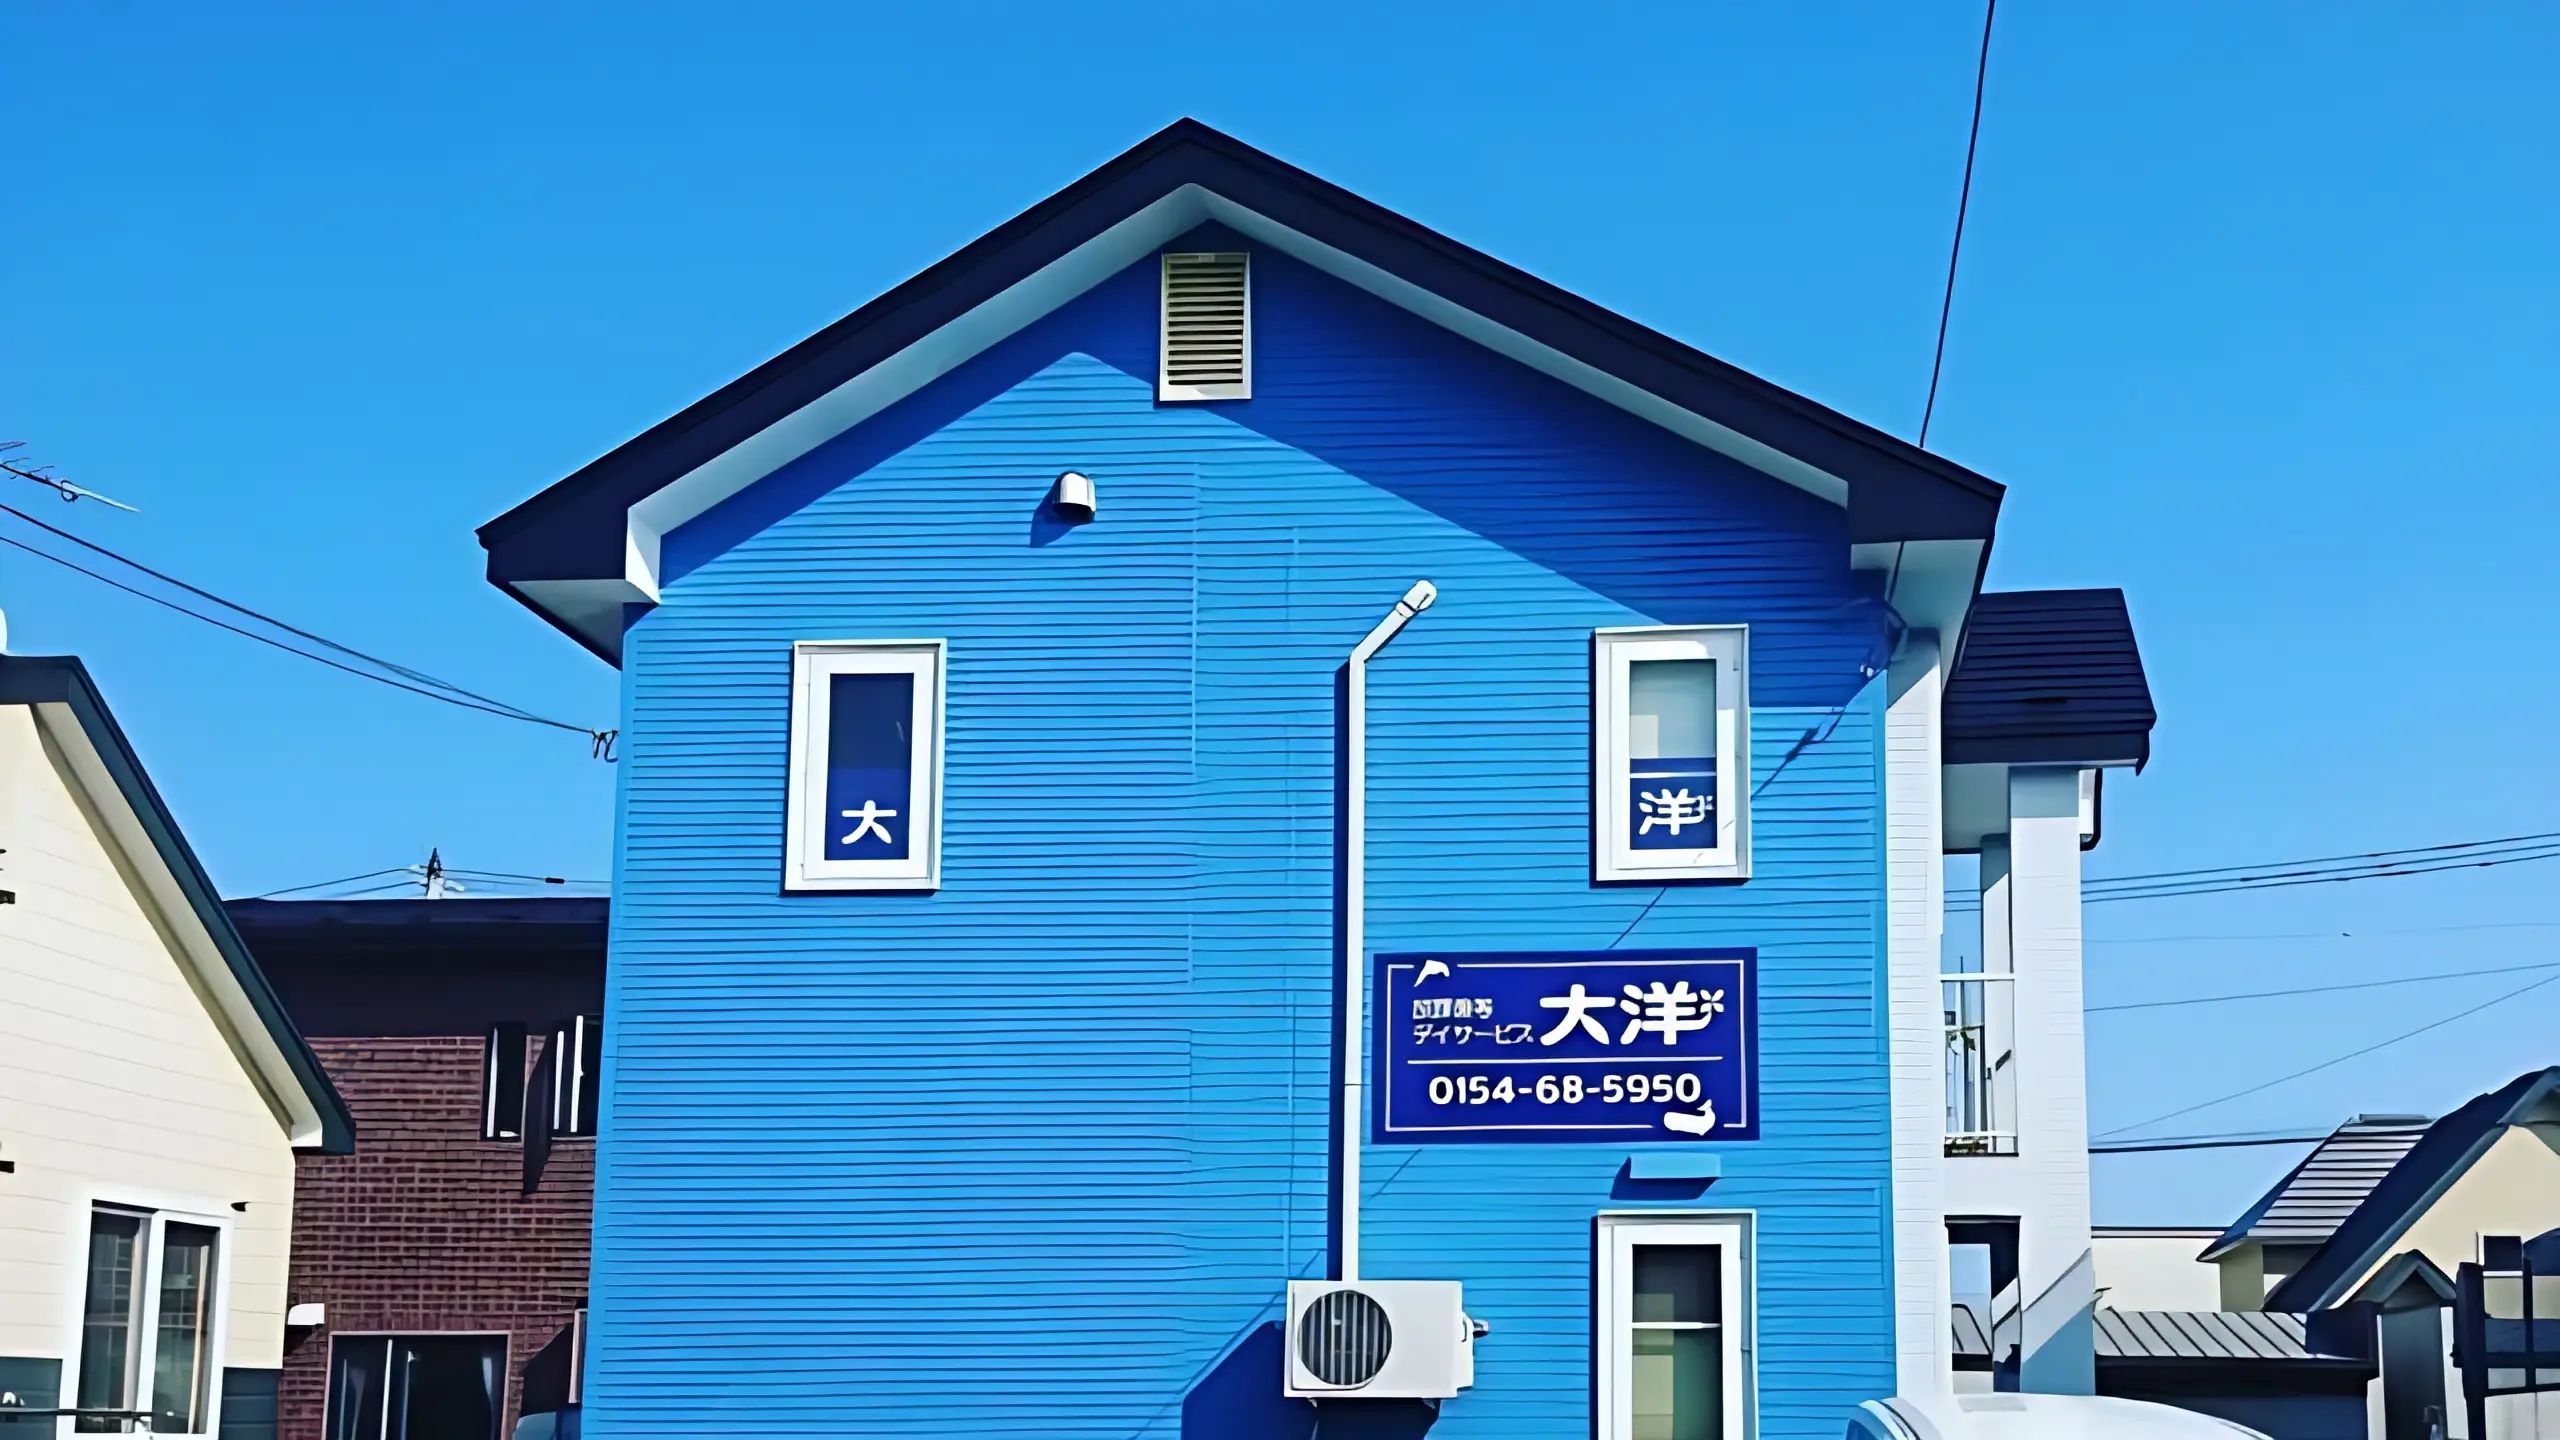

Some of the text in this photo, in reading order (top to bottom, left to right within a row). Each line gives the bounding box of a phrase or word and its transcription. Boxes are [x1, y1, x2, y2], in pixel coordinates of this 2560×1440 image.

[841, 799, 897, 845] 大
[1539, 980, 1724, 1046] 大洋
[1428, 1073, 1701, 1105] 0154-68-5950
